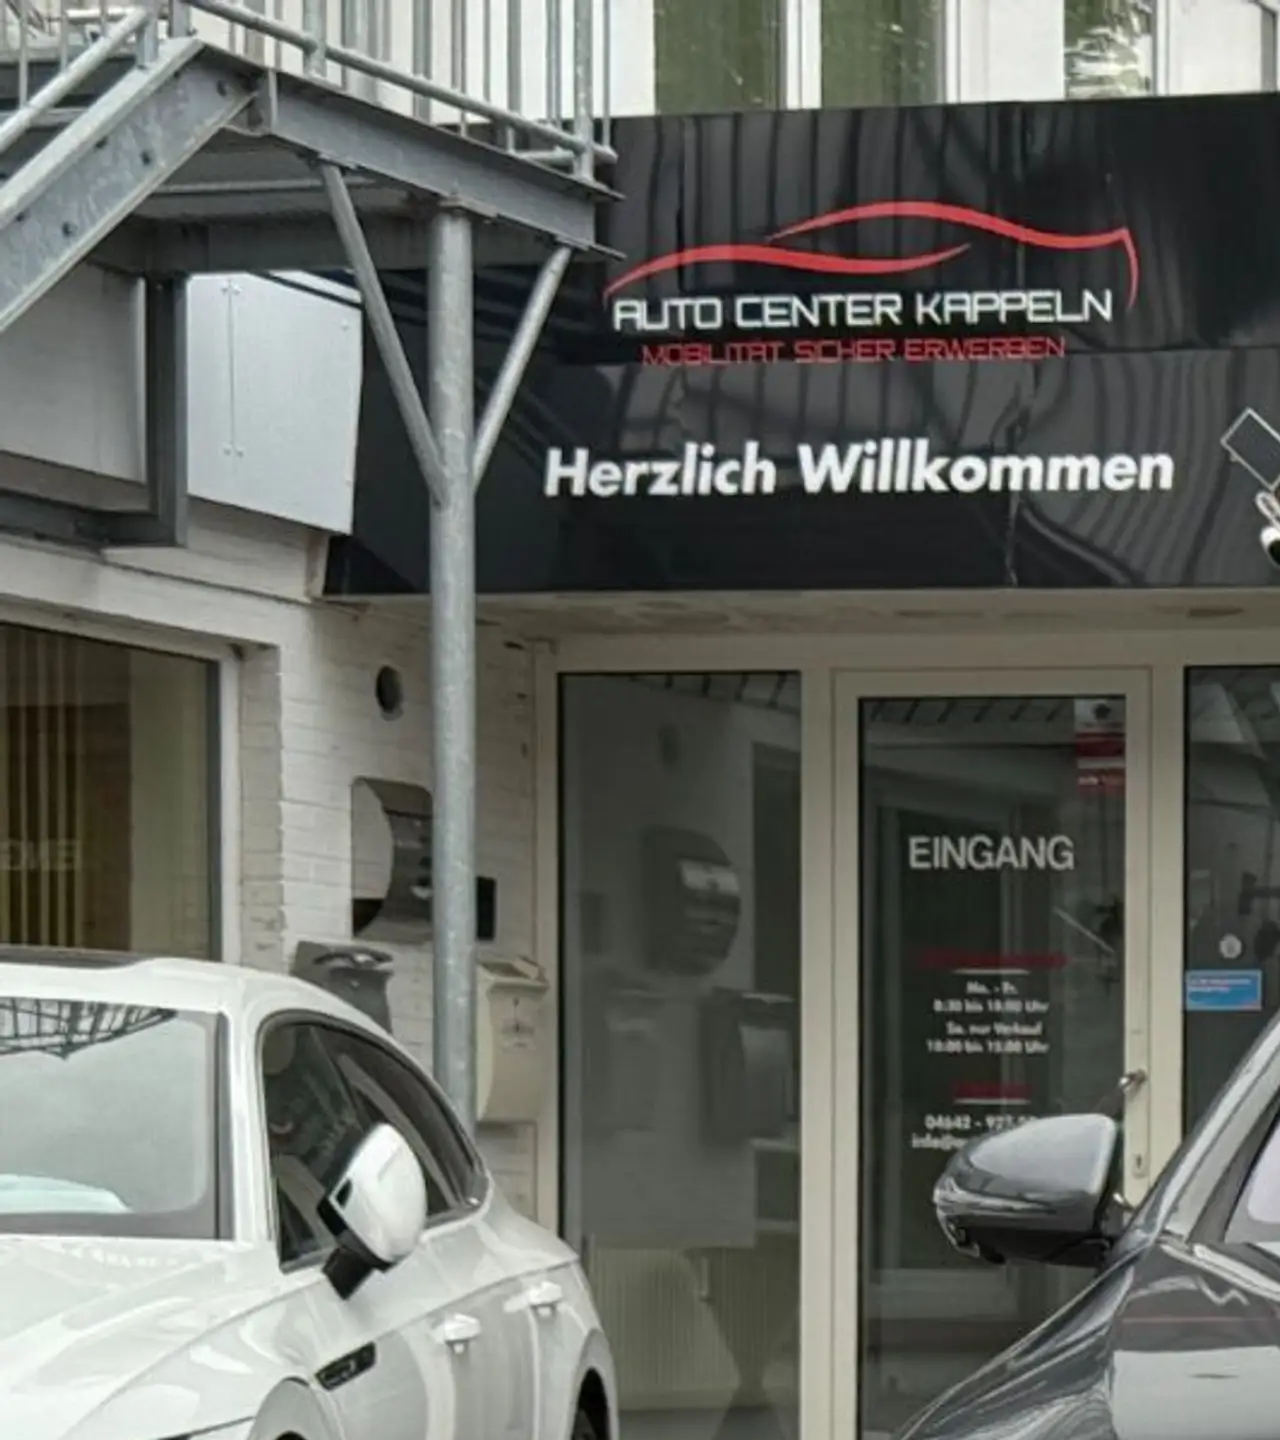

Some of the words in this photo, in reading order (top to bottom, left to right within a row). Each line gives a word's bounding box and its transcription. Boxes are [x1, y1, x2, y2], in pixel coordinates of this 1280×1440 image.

[612, 297, 722, 331] AUTO
[735, 293, 903, 327] CENTER
[915, 289, 1113, 325] KAPPELN
[794, 338, 896, 364] SICHER
[904, 335, 1066, 362] ERWERBEN
[544, 442, 776, 498] Herzlich
[798, 437, 1174, 492] Willkommen
[908, 835, 1075, 871] EINGANG
